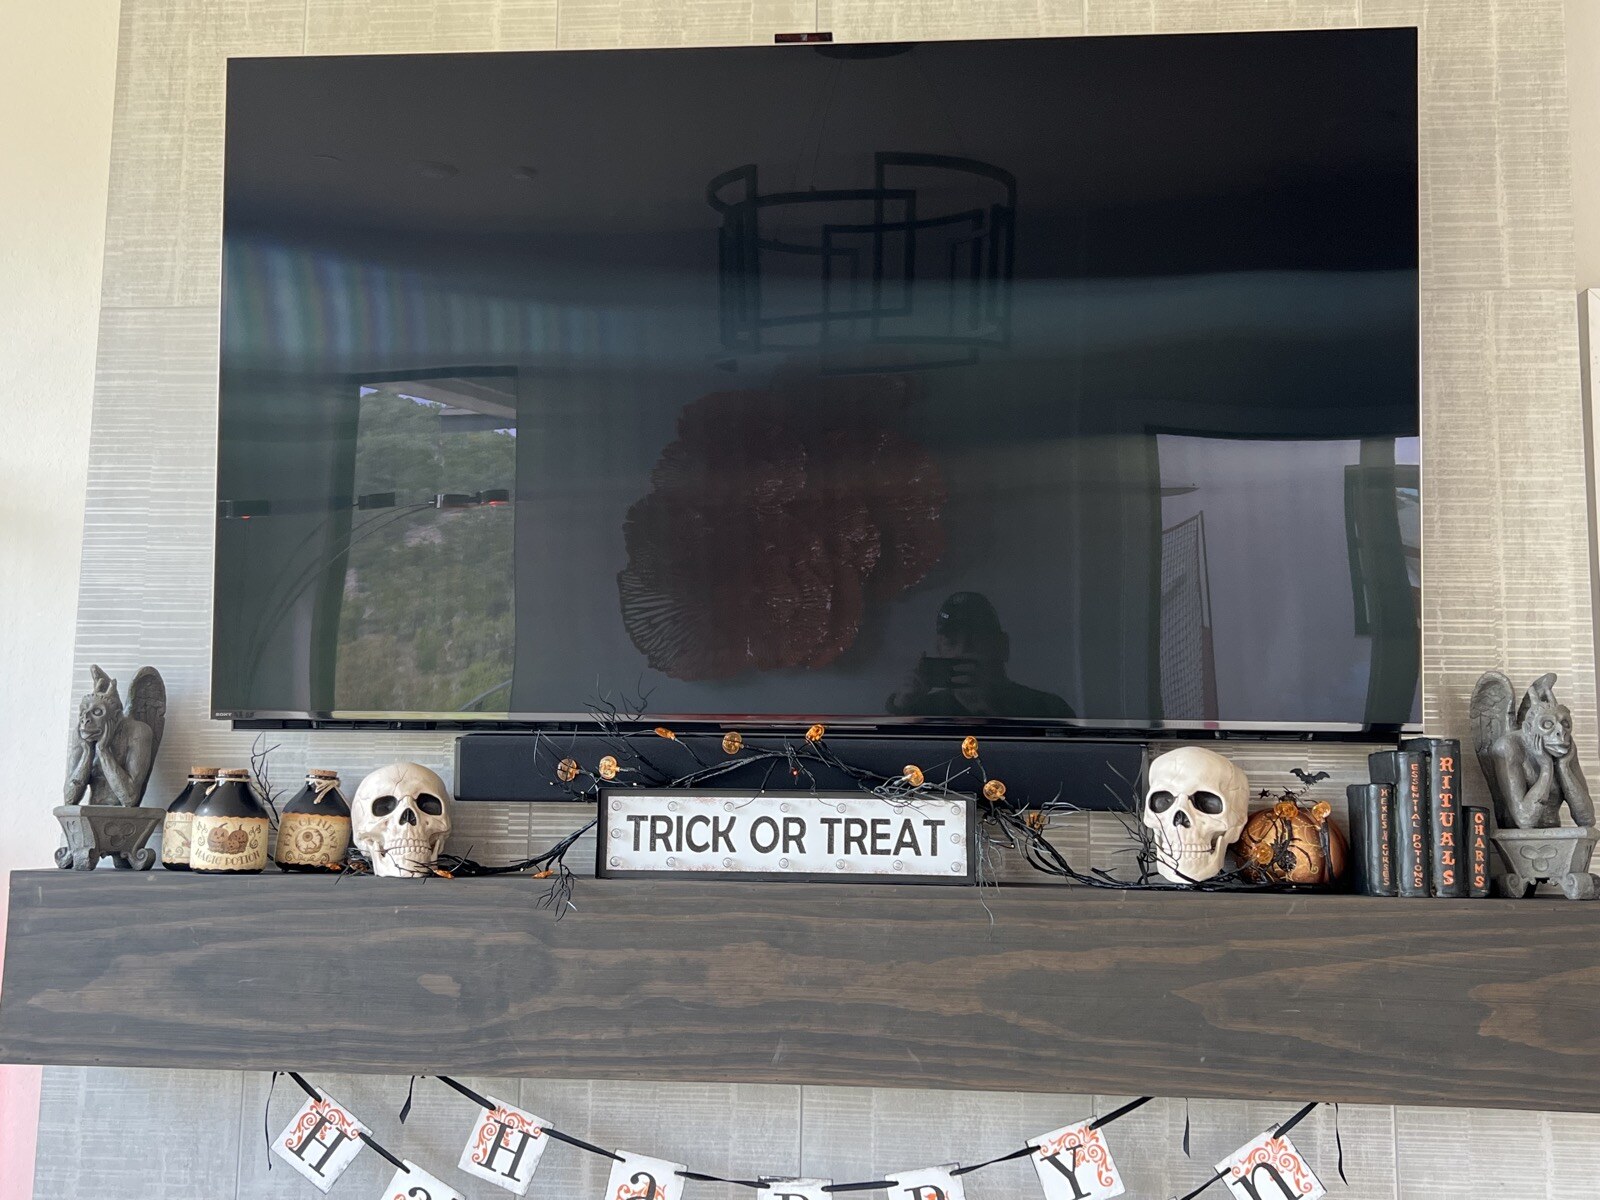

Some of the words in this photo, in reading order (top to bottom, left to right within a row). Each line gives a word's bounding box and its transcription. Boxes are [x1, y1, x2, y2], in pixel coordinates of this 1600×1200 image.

[1380, 788, 1390, 829] HEXES
[1410, 763, 1420, 828] ESSENTIAL
[626, 814, 737, 853] TRICK
[750, 815, 807, 855] OR
[820, 817, 946, 857] TREAT
[1439, 757, 1455, 885] RITUALS
[195, 848, 221, 865] MAGIC
[225, 849, 260, 866] POTION
[1382, 843, 1390, 886] CURSES
[1412, 833, 1423, 888] POTIONS
[1474, 812, 1486, 887] CHARMS
